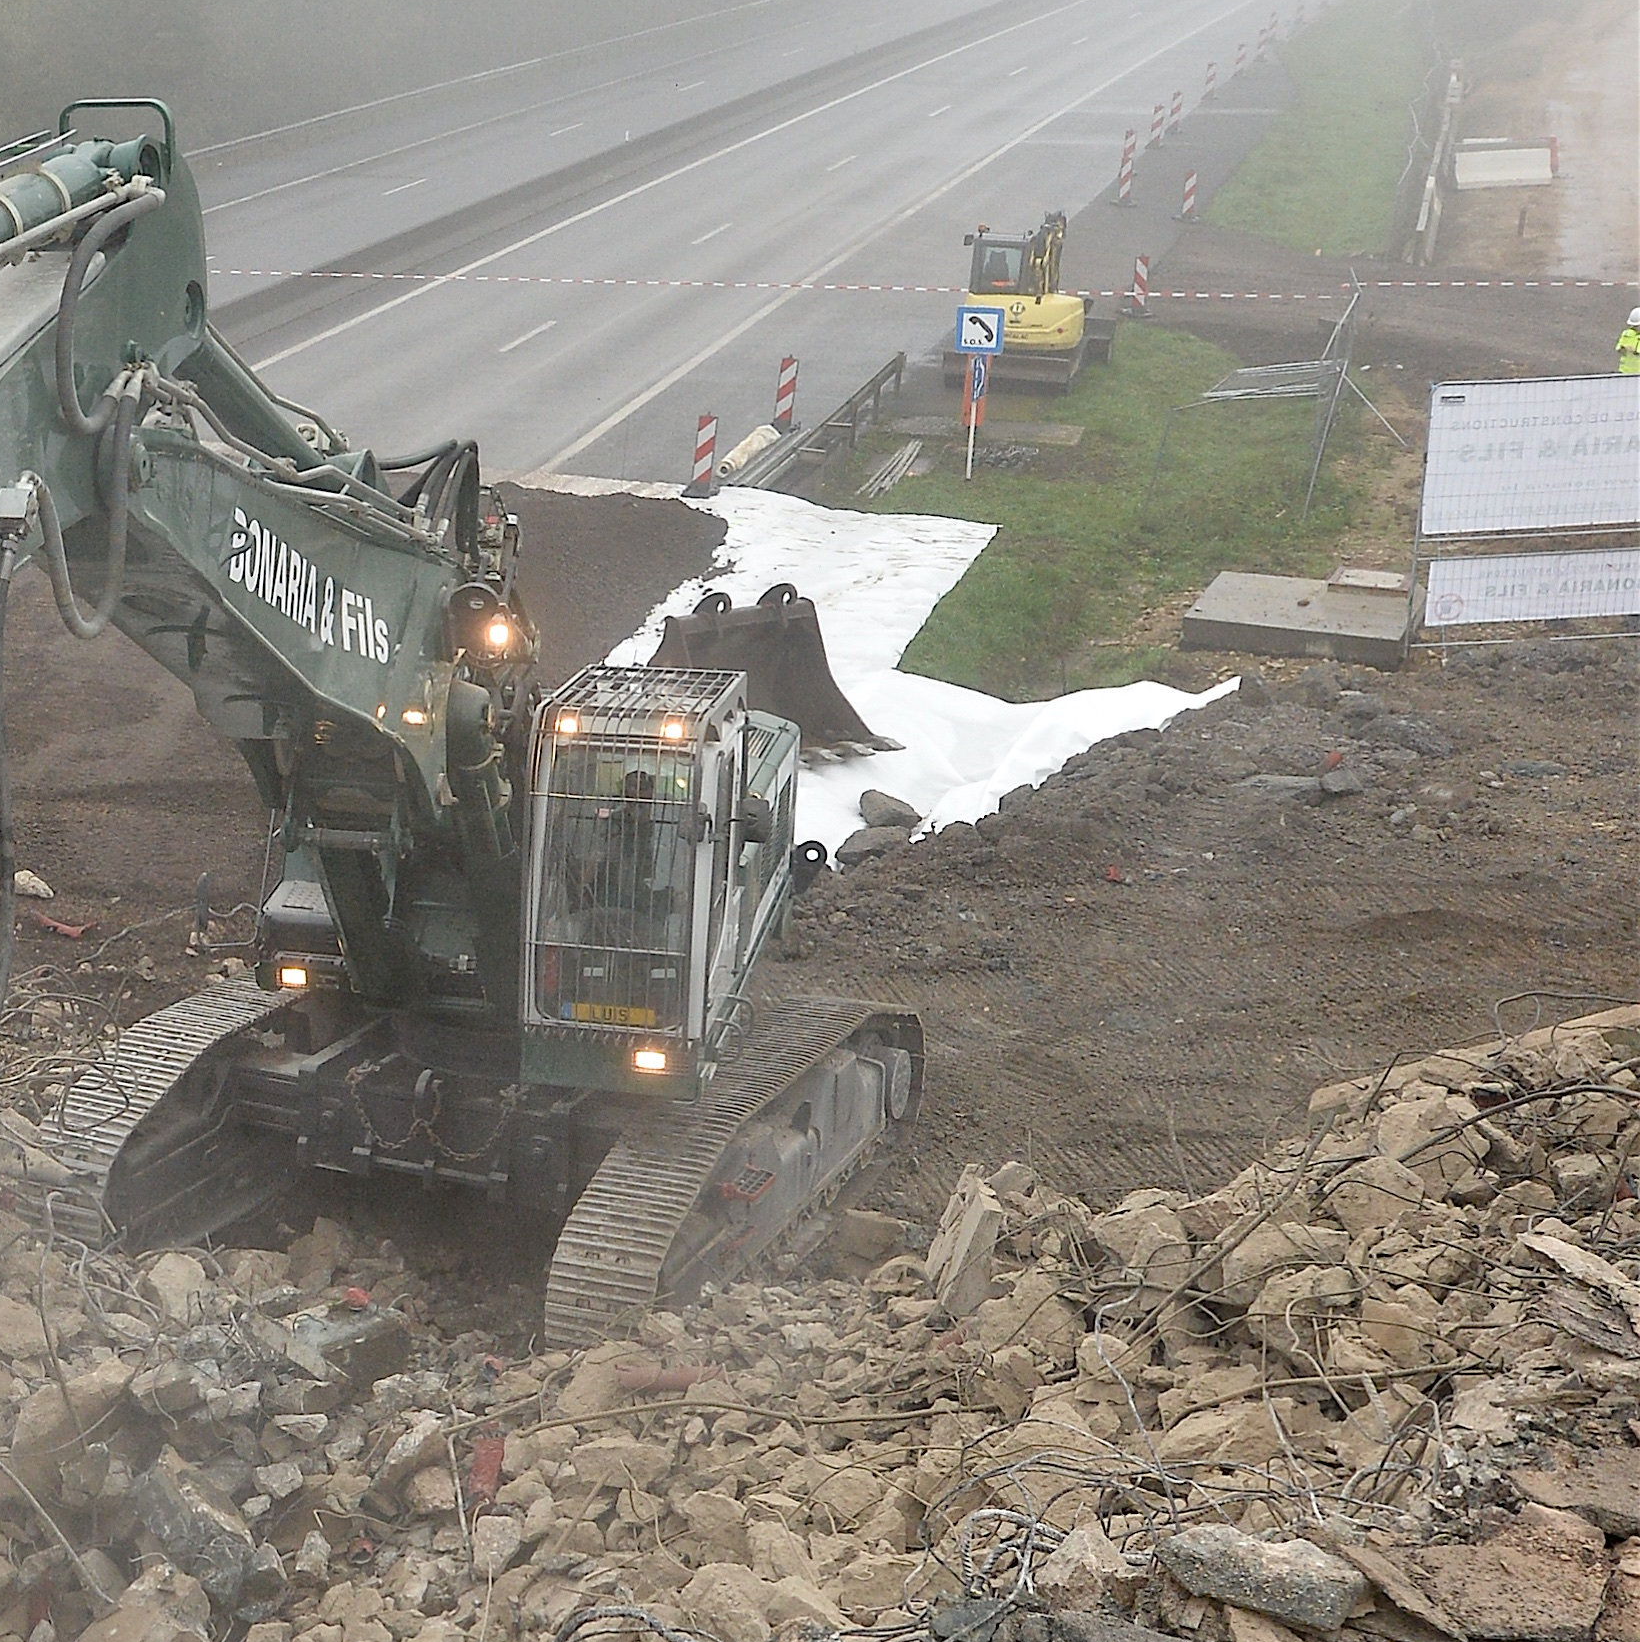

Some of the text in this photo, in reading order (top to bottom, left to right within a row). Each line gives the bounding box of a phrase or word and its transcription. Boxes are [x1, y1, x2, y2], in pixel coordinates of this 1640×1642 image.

[229, 507, 389, 664] BONARIA & Fils
